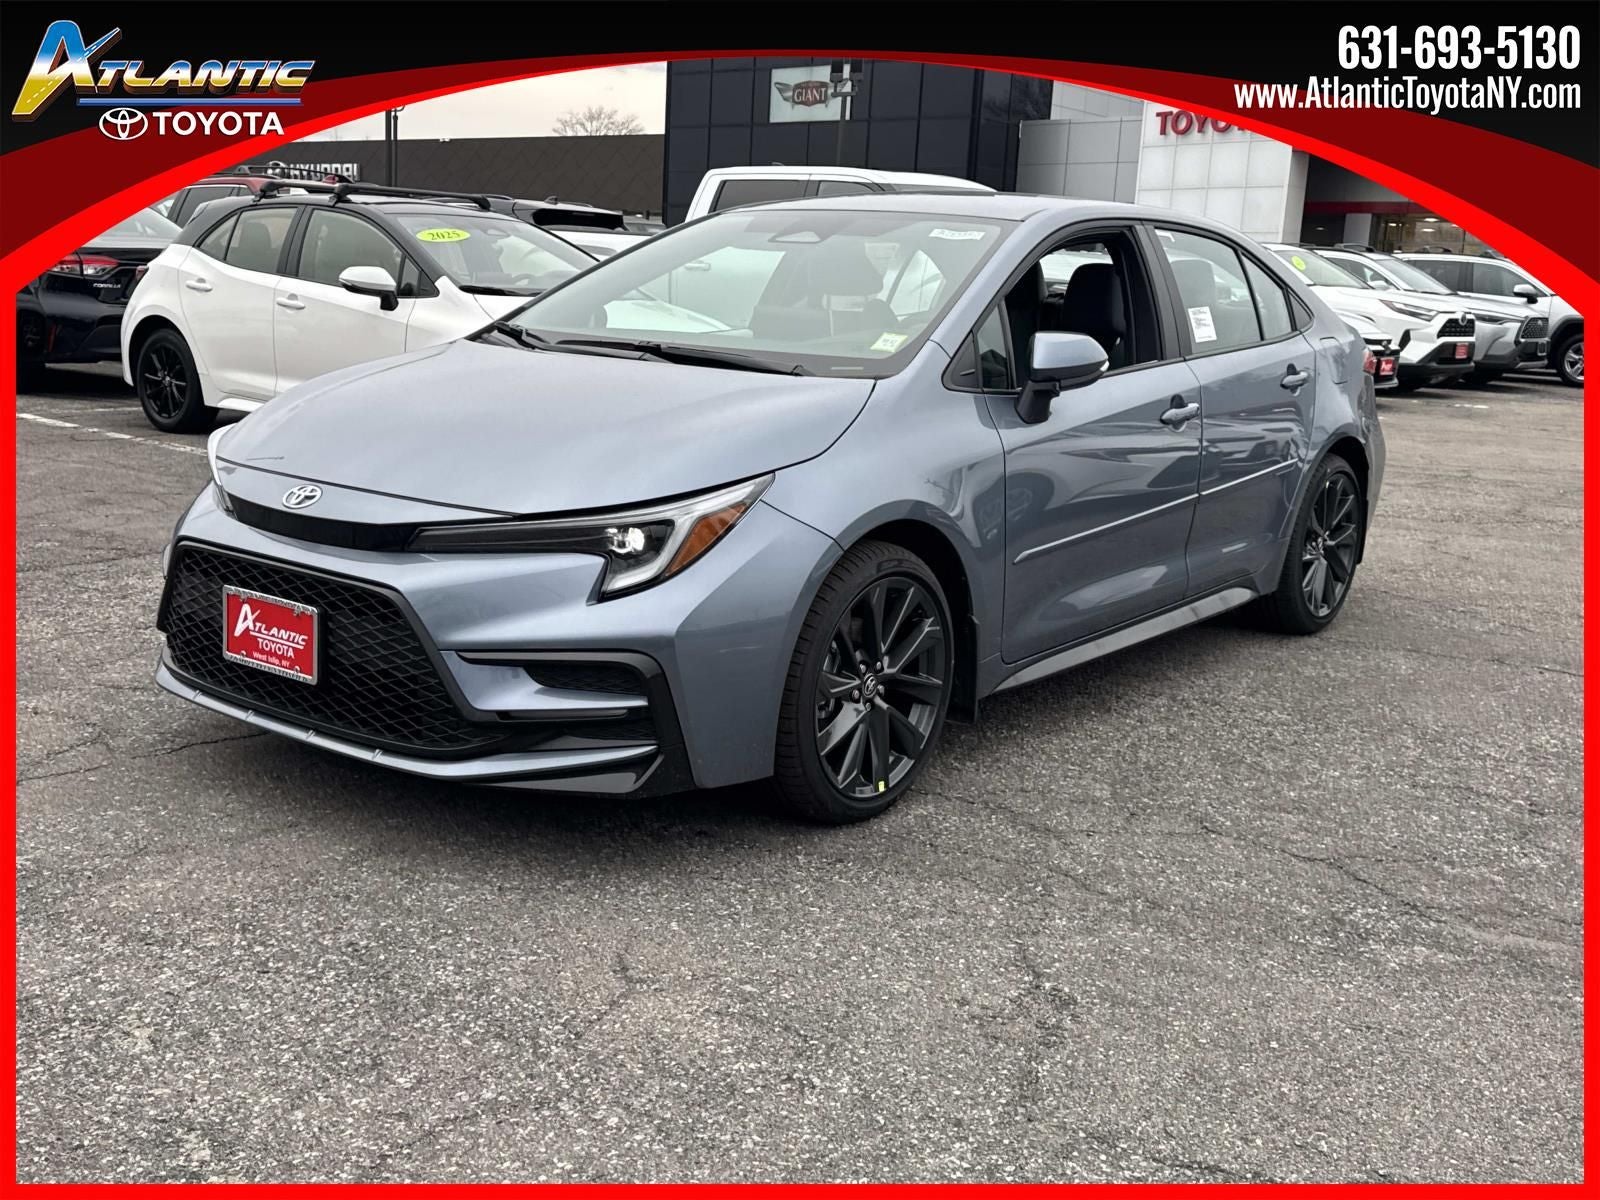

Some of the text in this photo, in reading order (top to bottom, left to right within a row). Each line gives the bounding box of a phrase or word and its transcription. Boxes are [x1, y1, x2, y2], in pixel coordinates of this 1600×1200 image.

[794, 88, 826, 102] GIANT
[1156, 110, 1245, 135] TOYO
[234, 603, 309, 646] ATLANTIC
[257, 638, 294, 659] TOYOTA
[282, 660, 290, 668] NY
